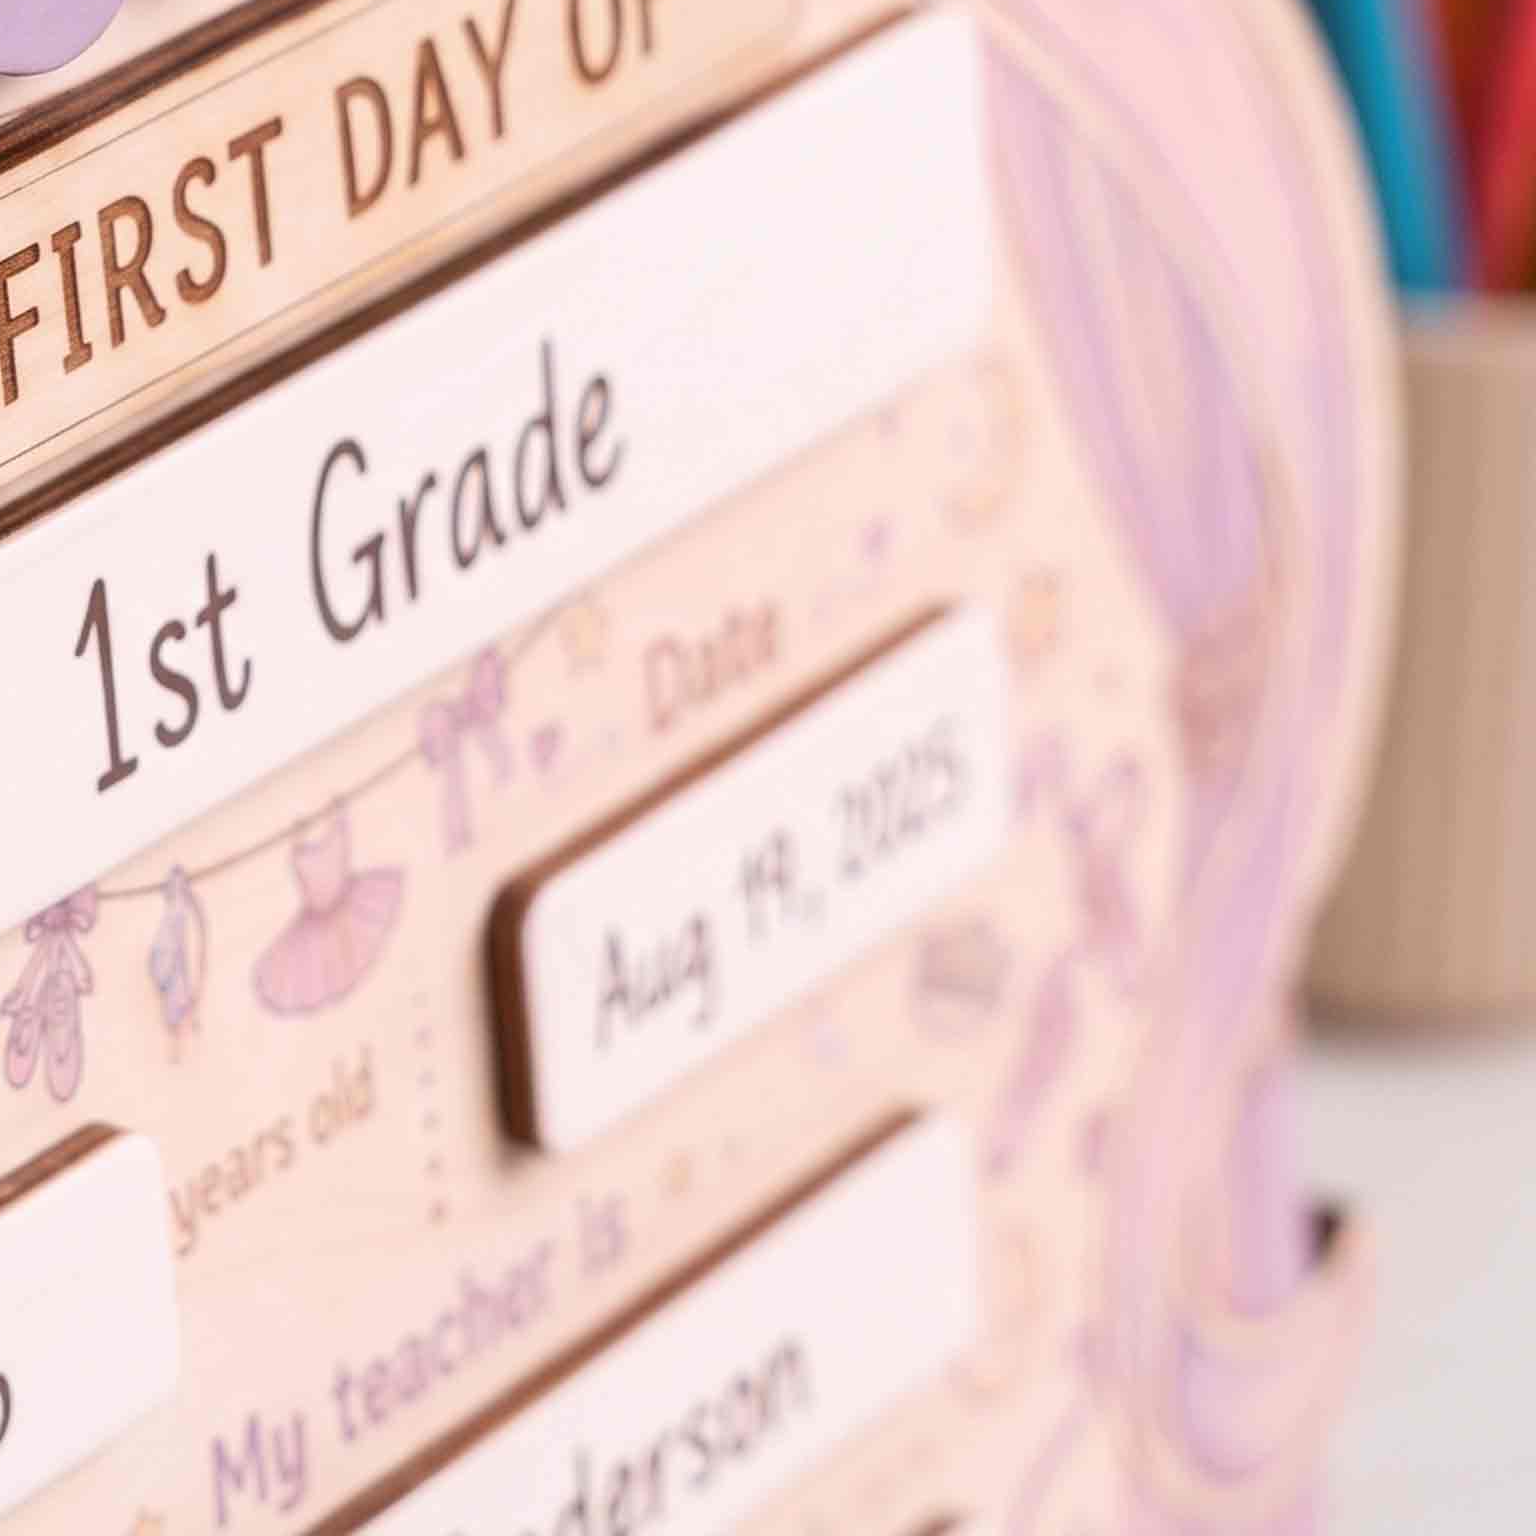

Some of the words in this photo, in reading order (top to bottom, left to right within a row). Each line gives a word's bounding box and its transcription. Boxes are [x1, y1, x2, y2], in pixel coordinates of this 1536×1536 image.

[74, 551, 252, 794] 1st
[310, 338, 624, 644] Grade
[644, 602, 782, 732] Date
[597, 912, 713, 1046] Aug
[838, 716, 968, 878] 2025
[168, 1114, 298, 1260] years
[308, 1040, 378, 1148] old
[210, 1410, 308, 1530] My
[328, 1239, 556, 1446] teacher
[447, 1334, 814, 1536] derson
